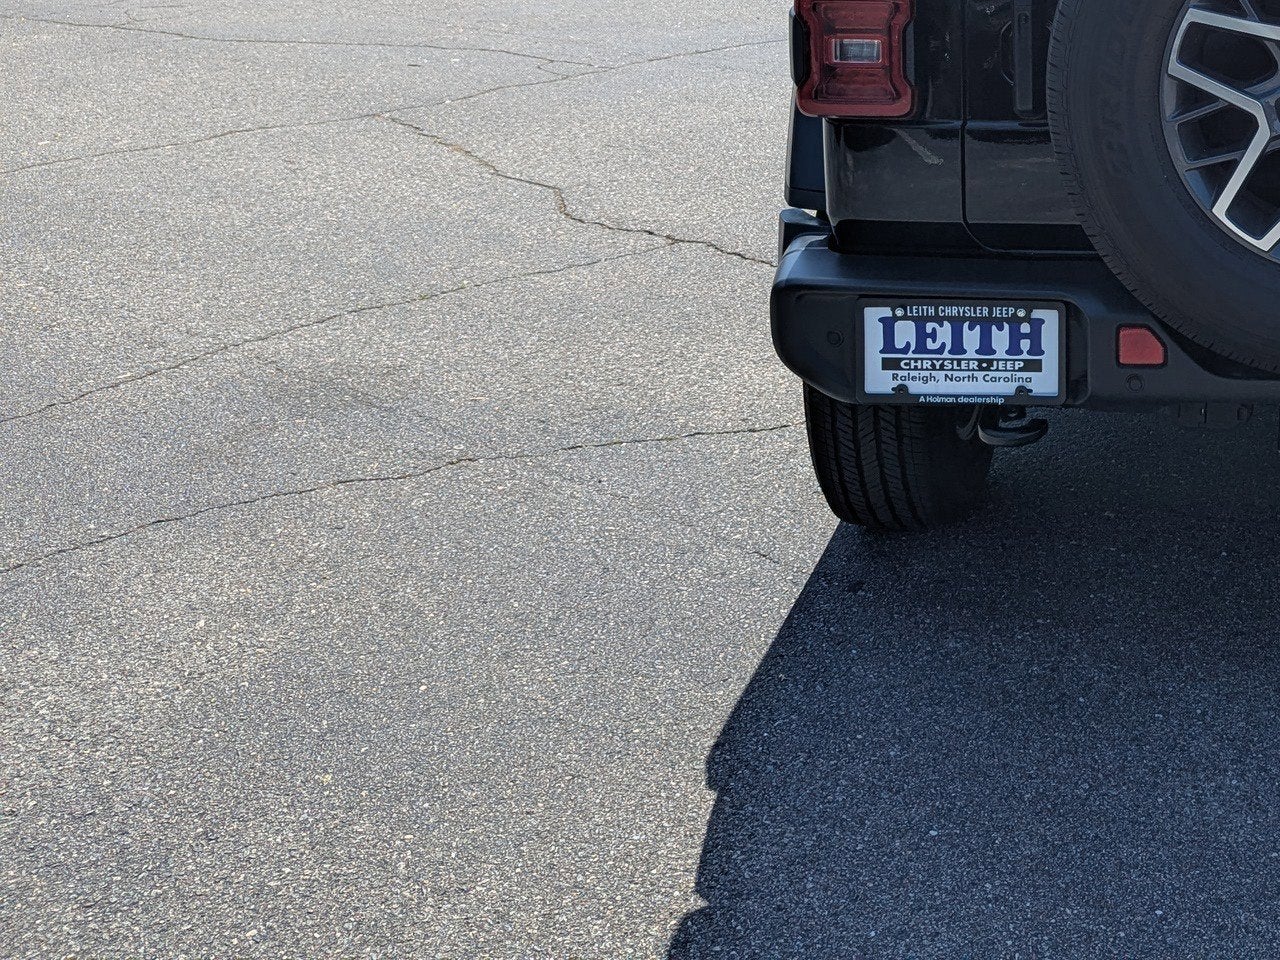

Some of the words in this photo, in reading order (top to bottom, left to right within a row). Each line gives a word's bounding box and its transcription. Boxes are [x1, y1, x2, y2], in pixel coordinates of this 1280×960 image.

[907, 306, 935, 317] LEITH
[938, 306, 989, 318] CHRYSLER
[992, 307, 1015, 318] JEEP
[878, 317, 1046, 356] LEITH
[900, 359, 979, 370] CHRYSLER
[990, 360, 1024, 371] JEEP
[891, 372, 940, 384] Raleigh,
[944, 373, 979, 383] North
[982, 373, 1033, 384] Carolina
[919, 395, 925, 403] A
[926, 395, 956, 403] Holman
[957, 395, 1005, 405] dealership
